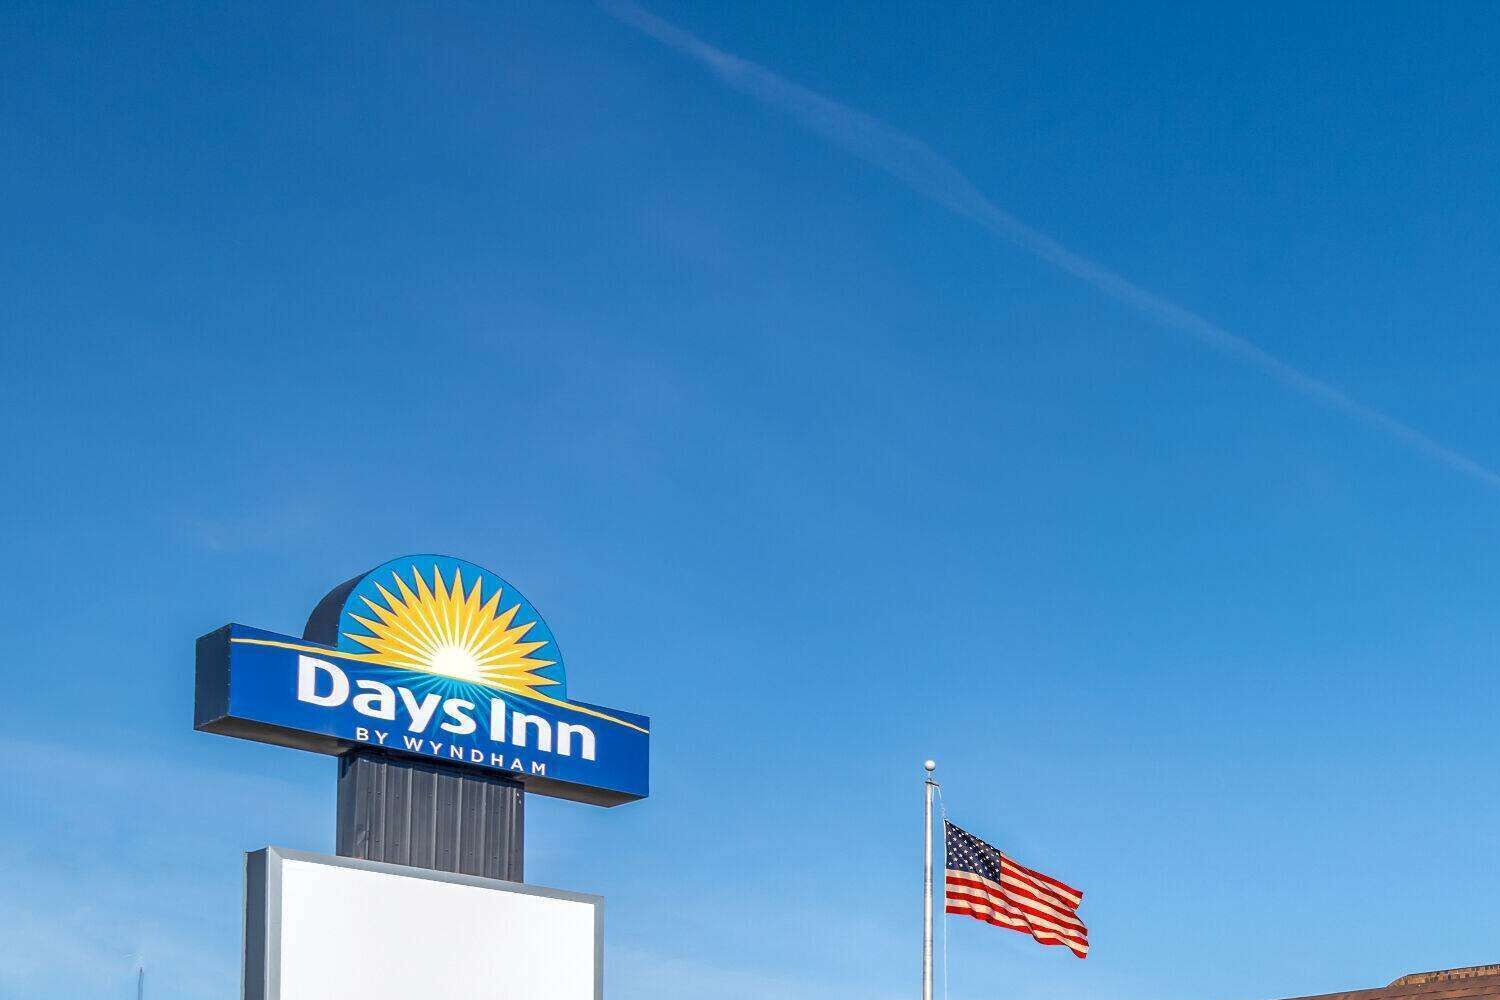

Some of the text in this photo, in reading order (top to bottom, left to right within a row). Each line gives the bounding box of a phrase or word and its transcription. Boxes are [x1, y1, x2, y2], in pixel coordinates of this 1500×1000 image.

[296, 653, 597, 761] Days Inn
[356, 726, 546, 776] BY WYNDHAM
